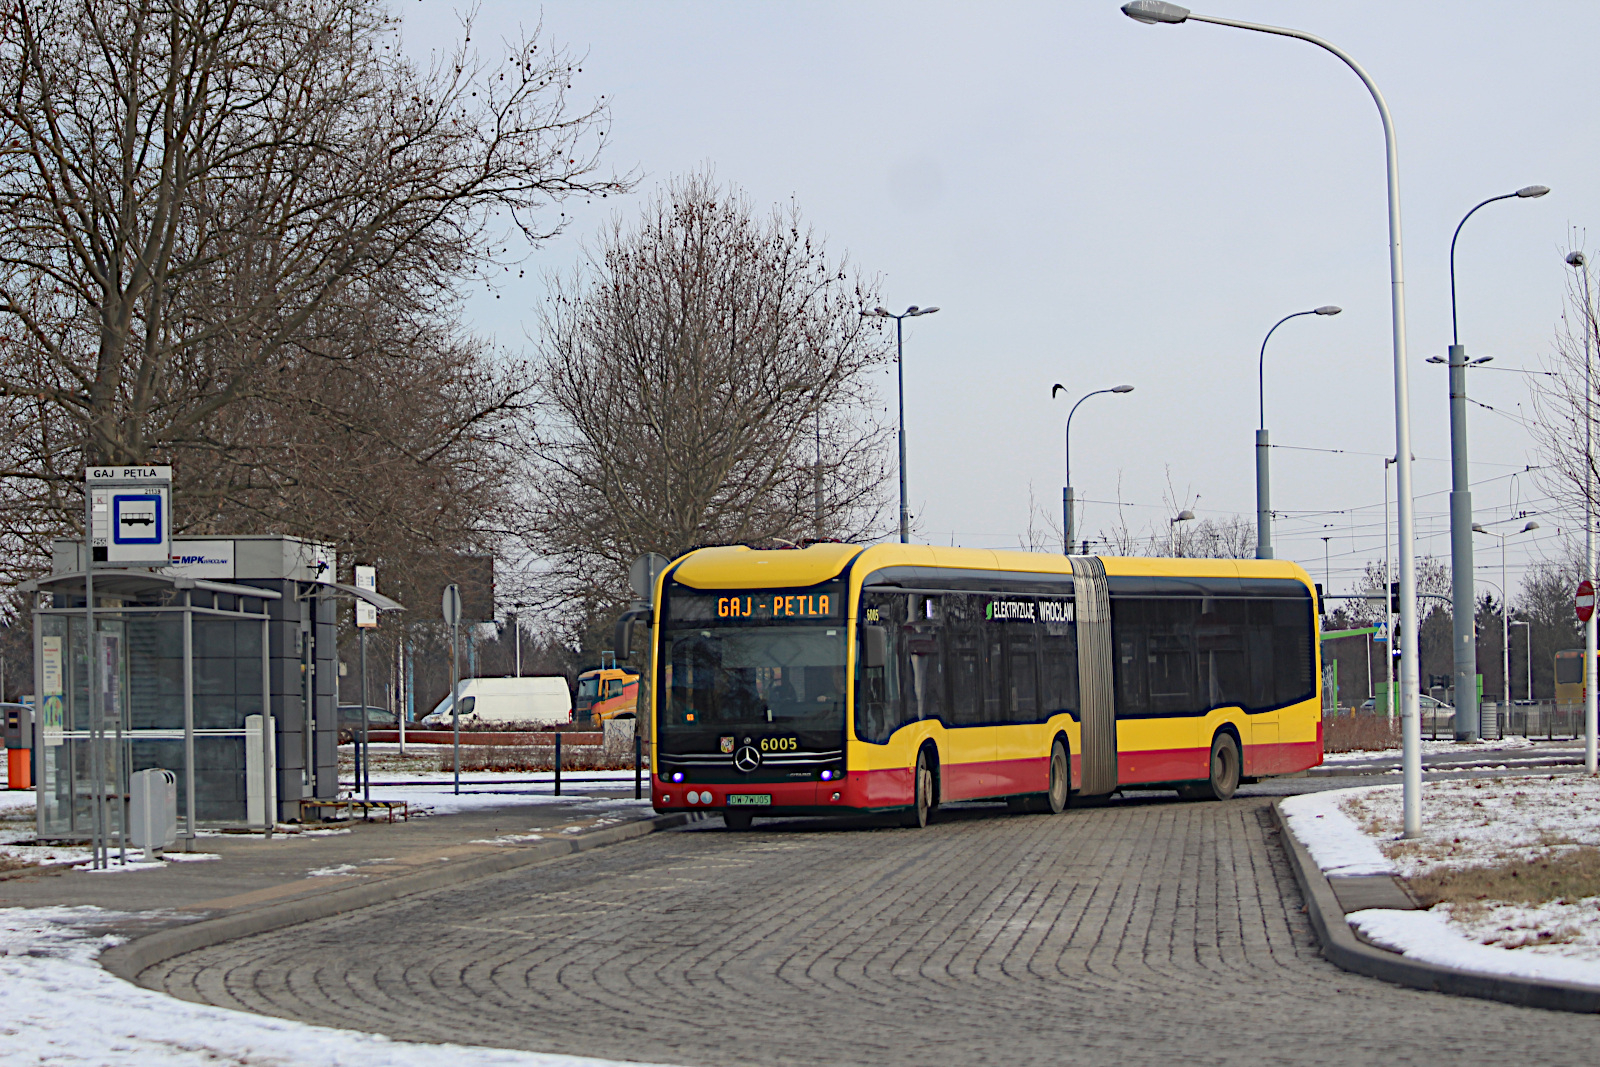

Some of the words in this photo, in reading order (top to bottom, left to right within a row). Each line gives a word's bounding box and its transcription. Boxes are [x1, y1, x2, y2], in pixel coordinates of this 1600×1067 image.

[93, 469, 114, 478] GAJ
[123, 468, 157, 479] PĘTLA
[97, 496, 104, 504] K
[181, 555, 204, 564] MPK
[717, 596, 752, 617] GAJ
[993, 601, 1035, 624] ELEKTRYZUJĘ
[1039, 601, 1074, 622] WROCŁAW
[866, 608, 879, 621] 6005
[760, 737, 798, 751] 6005
[731, 795, 742, 804] DW
